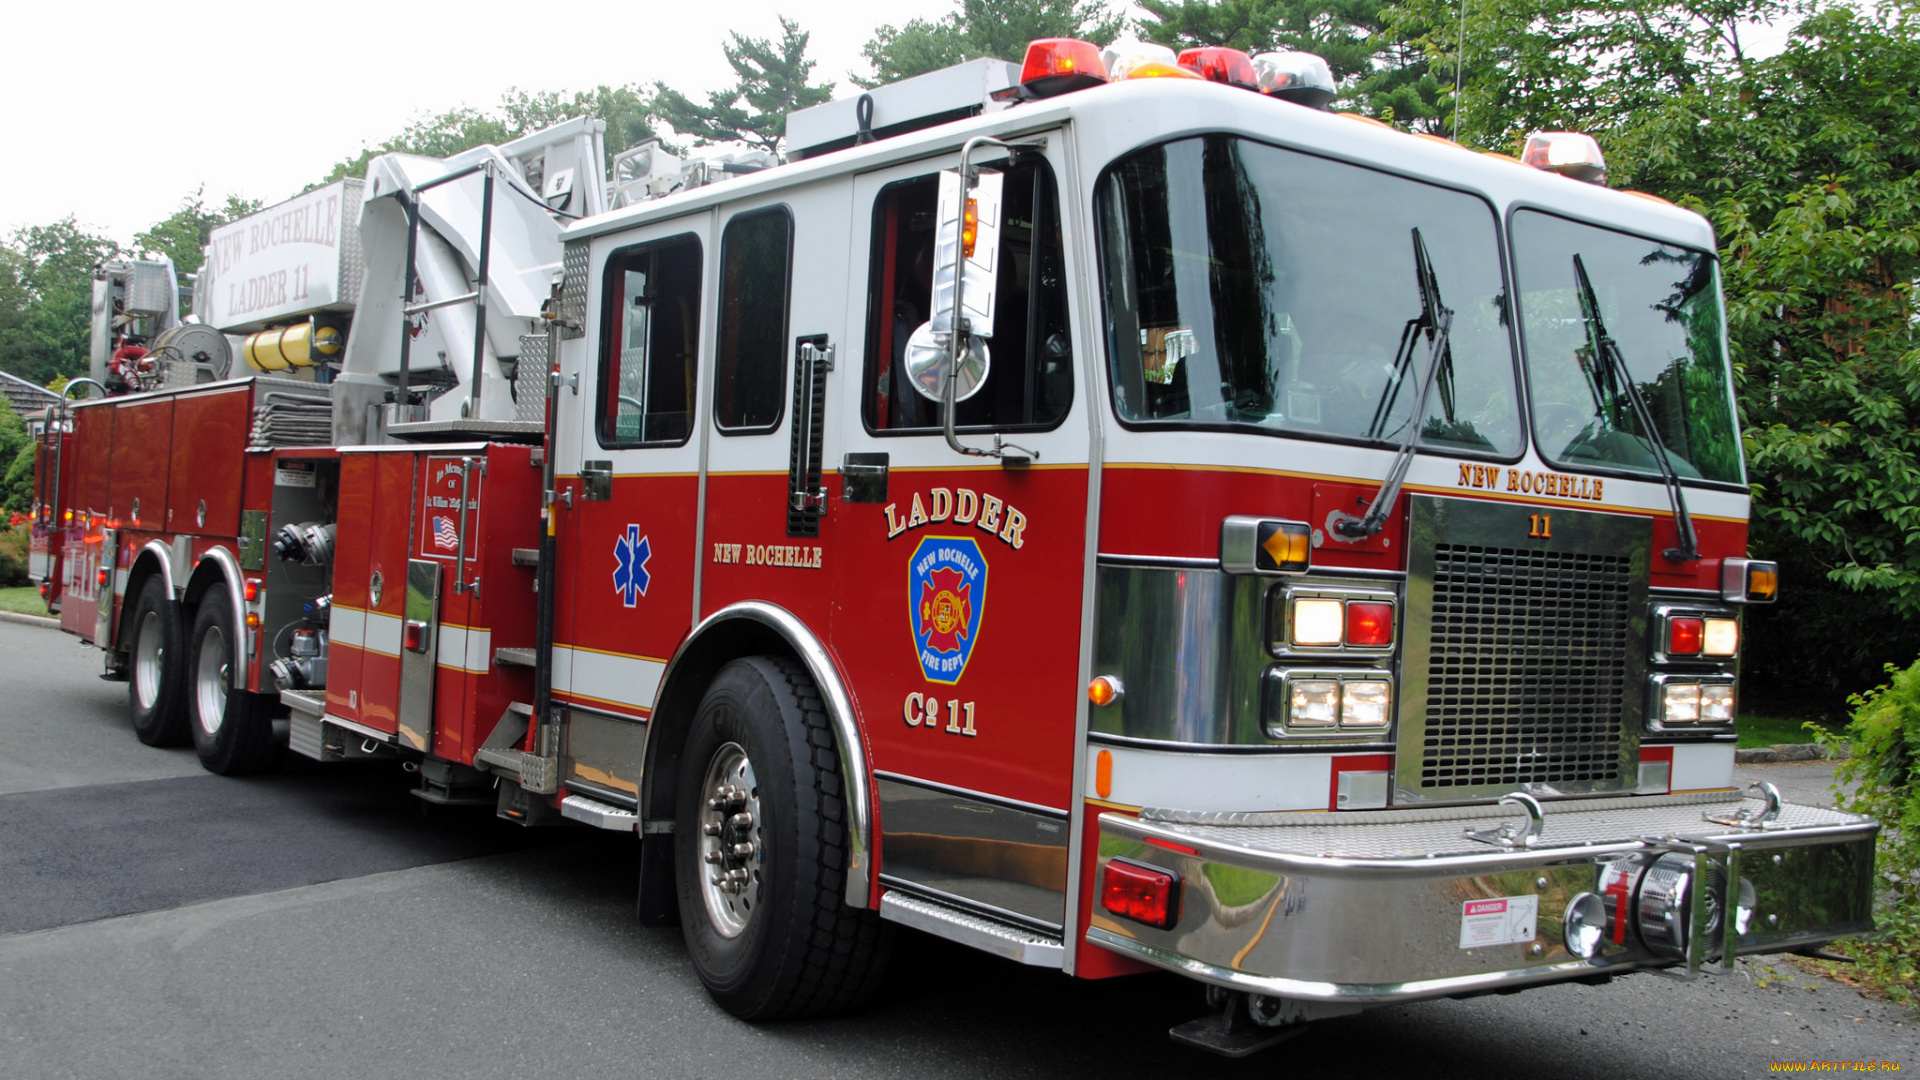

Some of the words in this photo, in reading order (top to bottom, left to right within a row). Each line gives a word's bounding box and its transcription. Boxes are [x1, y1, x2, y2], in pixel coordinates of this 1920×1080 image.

[212, 229, 245, 285] NEW
[249, 195, 338, 256] ROCHELLE
[228, 269, 287, 317] LADDER
[293, 263, 309, 301] 11
[1458, 463, 1500, 489] NEW
[1507, 469, 1604, 500] ROCHELLE
[884, 487, 1027, 550] LADDER
[1529, 513, 1552, 538] 11
[713, 543, 742, 564] NEW
[746, 544, 822, 569] ROCHELLE
[917, 551, 936, 577] NEW
[938, 547, 979, 580] ROCHELLE
[921, 649, 940, 671] FIRE
[942, 653, 963, 672] DEPT
[946, 699, 977, 736] 11
[1476, 902, 1503, 913] DANGER
